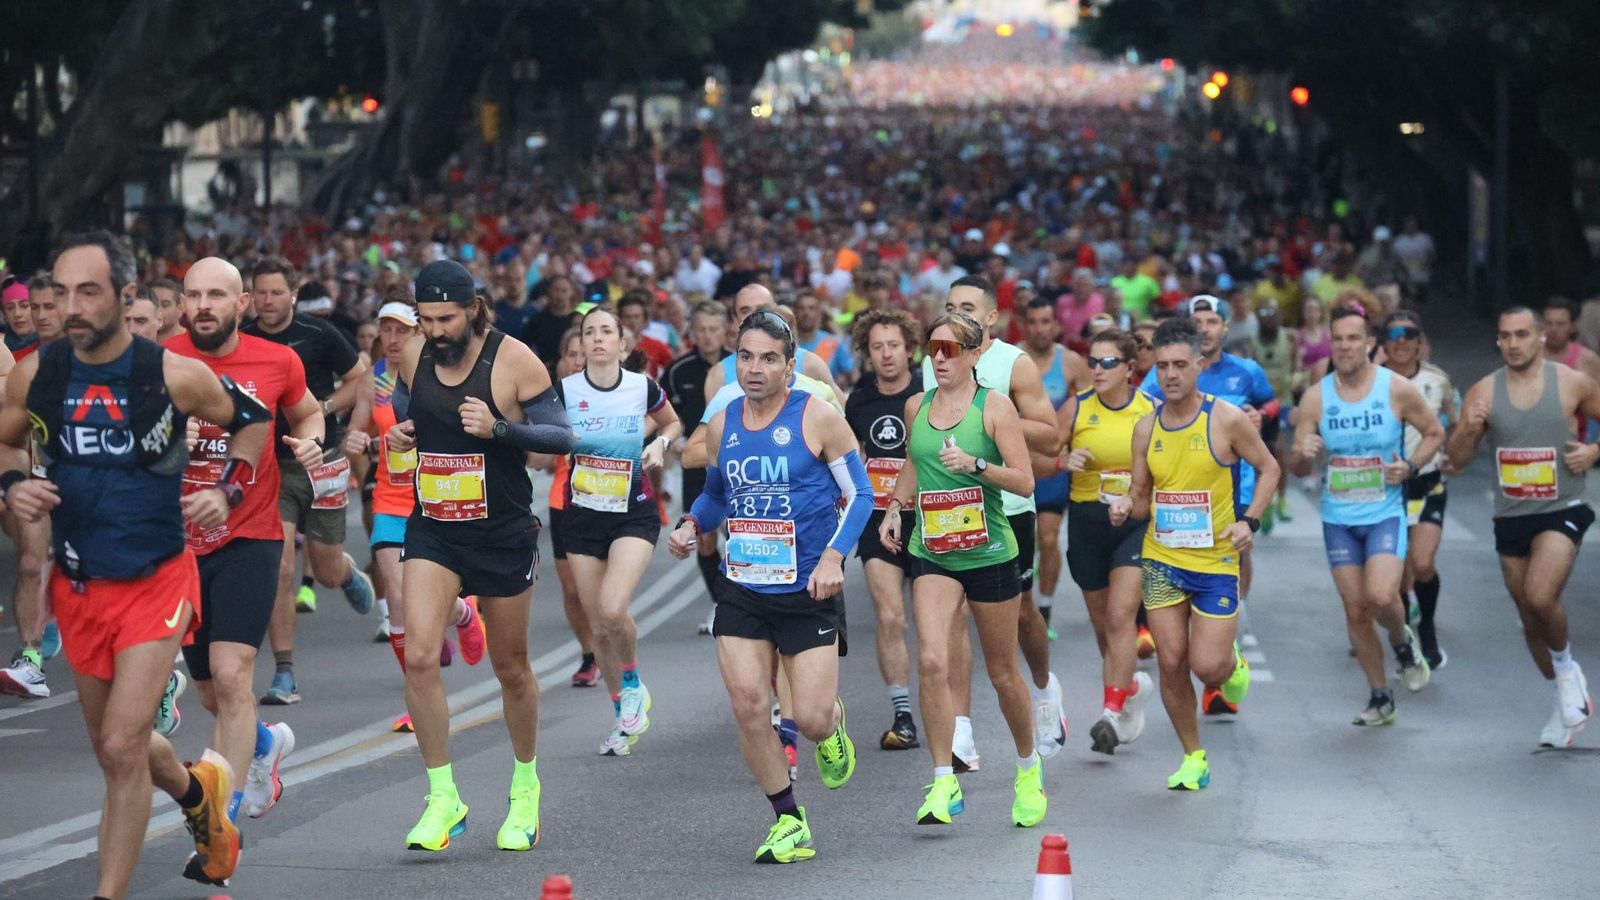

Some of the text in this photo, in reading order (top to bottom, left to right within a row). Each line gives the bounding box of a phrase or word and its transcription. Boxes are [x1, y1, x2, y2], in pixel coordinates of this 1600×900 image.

[1328, 411, 1383, 431] nerja
[198, 439, 227, 452] 746
[726, 456, 790, 488] RCM
[436, 479, 459, 490] 947
[934, 491, 978, 503] GENERALI
[1167, 494, 1205, 503] GENERALI
[730, 495, 792, 516] 1873
[939, 512, 963, 525] 827
[1163, 511, 1197, 523] 17699
[739, 543, 779, 556] 12502
